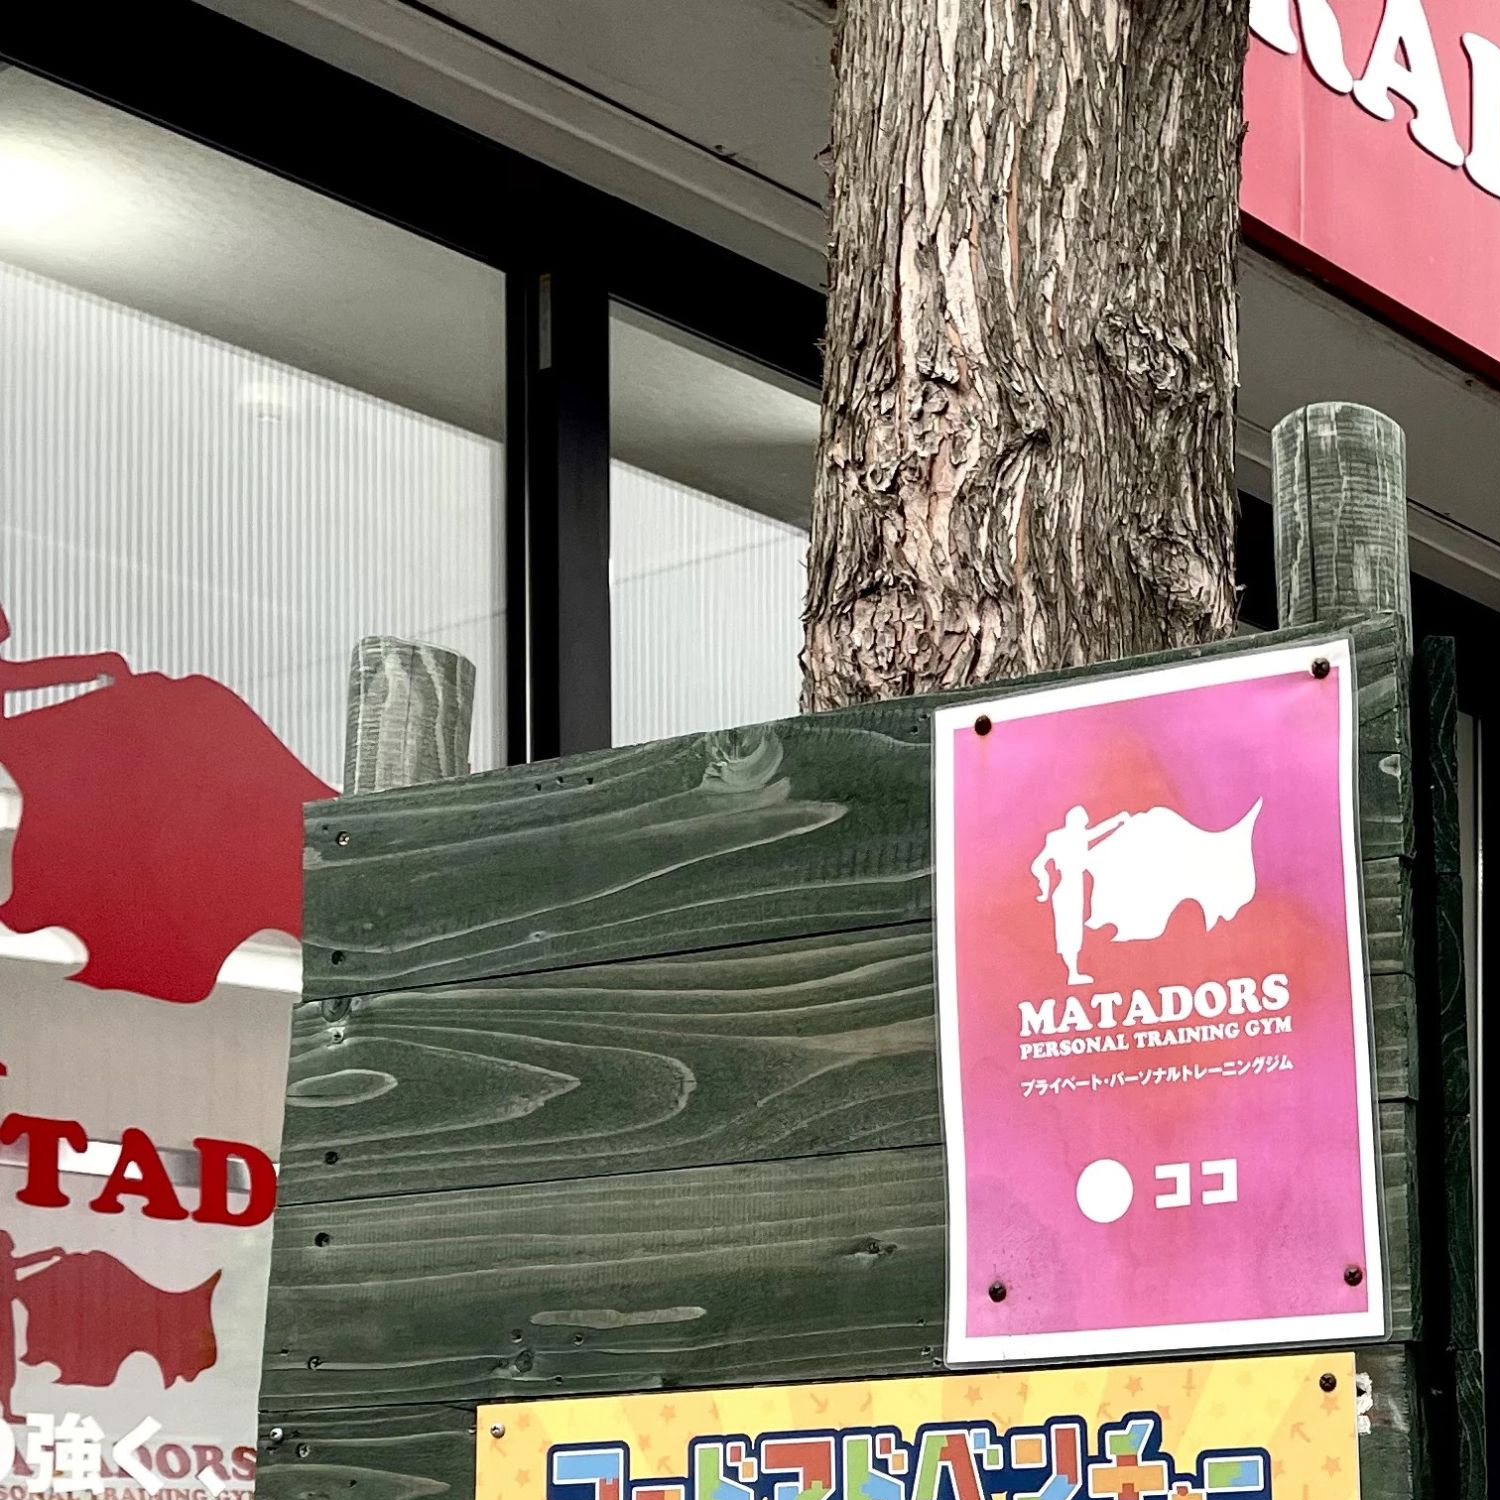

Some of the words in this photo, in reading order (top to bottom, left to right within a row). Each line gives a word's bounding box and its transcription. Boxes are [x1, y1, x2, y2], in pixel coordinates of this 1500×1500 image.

[1018, 973, 1291, 1037] MATADORS
[1019, 1033, 1130, 1060] PERSONAL
[1133, 1021, 1240, 1049] TRAINING
[1245, 1015, 1292, 1037] GYM
[1020, 1054, 1293, 1098] プライベート・パーソナルトレーニングジム
[0, 1113, 277, 1227] TAD
[1154, 1158, 1239, 1209] ココ
